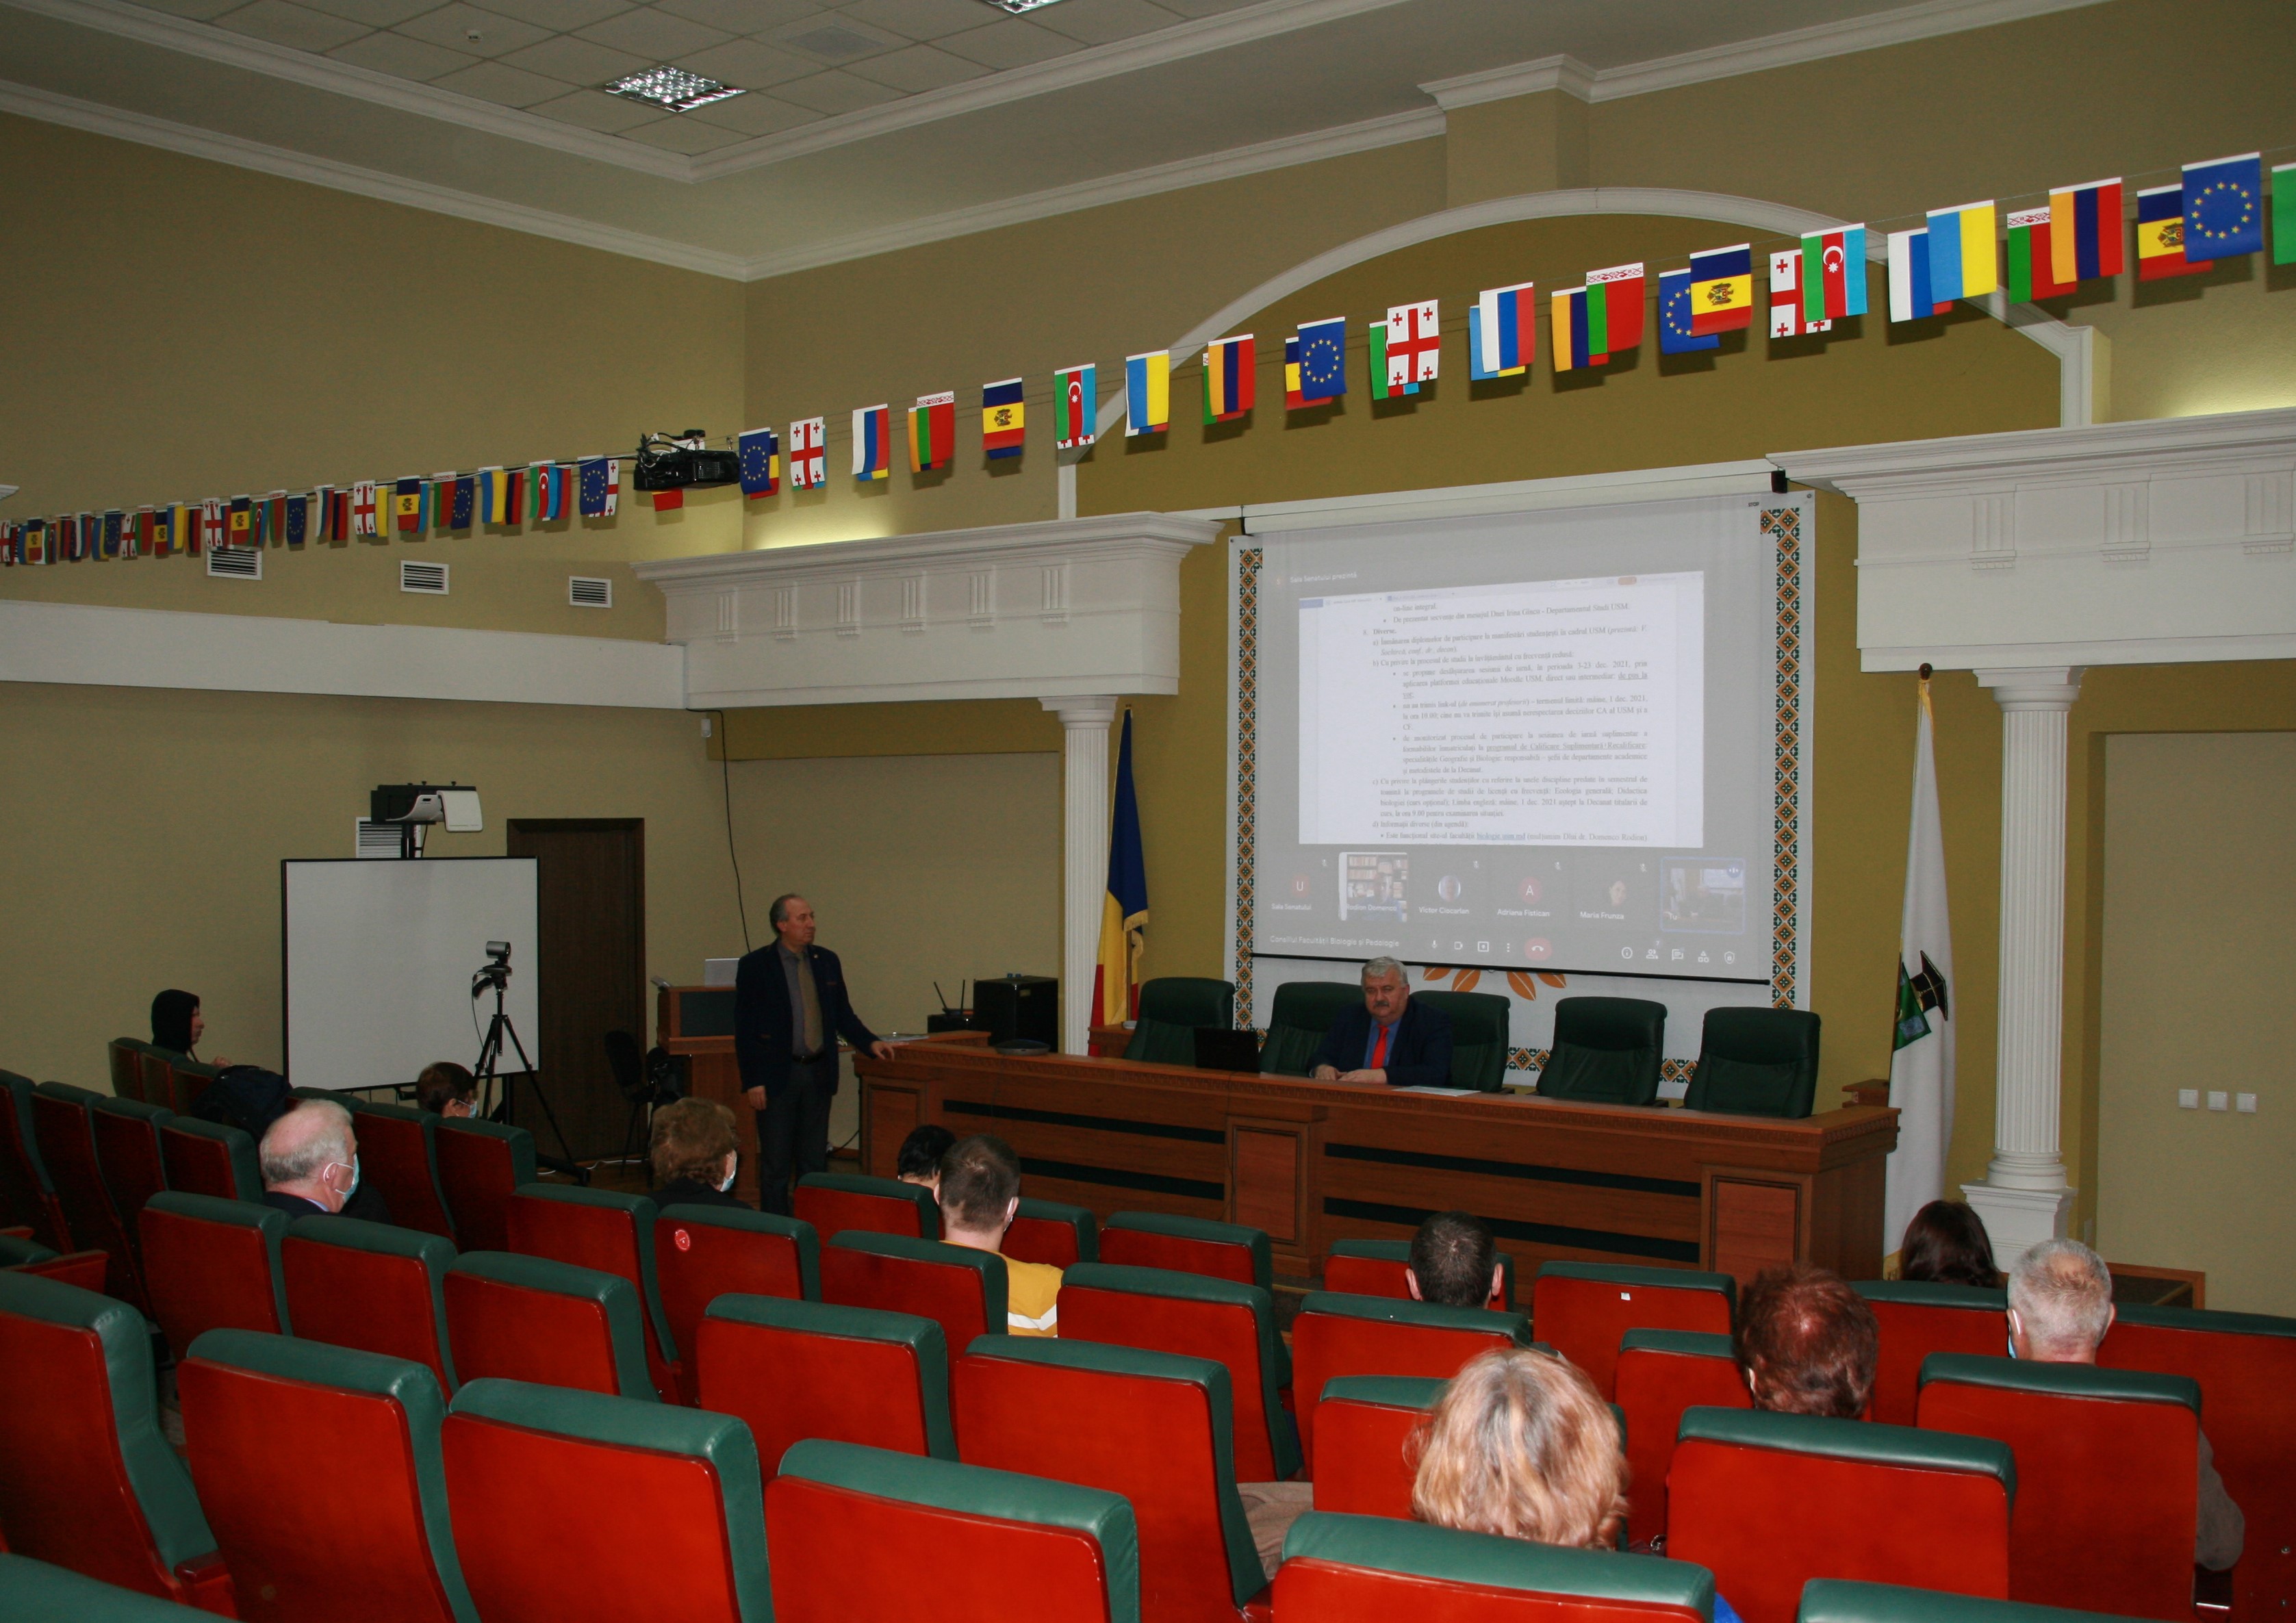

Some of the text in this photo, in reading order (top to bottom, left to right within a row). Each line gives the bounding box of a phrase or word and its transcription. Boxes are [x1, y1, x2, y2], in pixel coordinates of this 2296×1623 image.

[1452, 634, 1483, 642] participare
[1547, 663, 1573, 673] perioada
[1440, 755, 1468, 763] Geografie
[1571, 753, 1613, 761] departamente
[1542, 776, 1572, 784] discipline
[1574, 776, 1596, 784] predate
[1525, 885, 1534, 895] A
[1439, 907, 1470, 915] Ciocarlan
[1496, 908, 1523, 917] Adriana
[1579, 911, 1624, 920] Maria Frunza
[1330, 937, 1357, 945] Biologie
[1365, 938, 1399, 947] Pedologie
